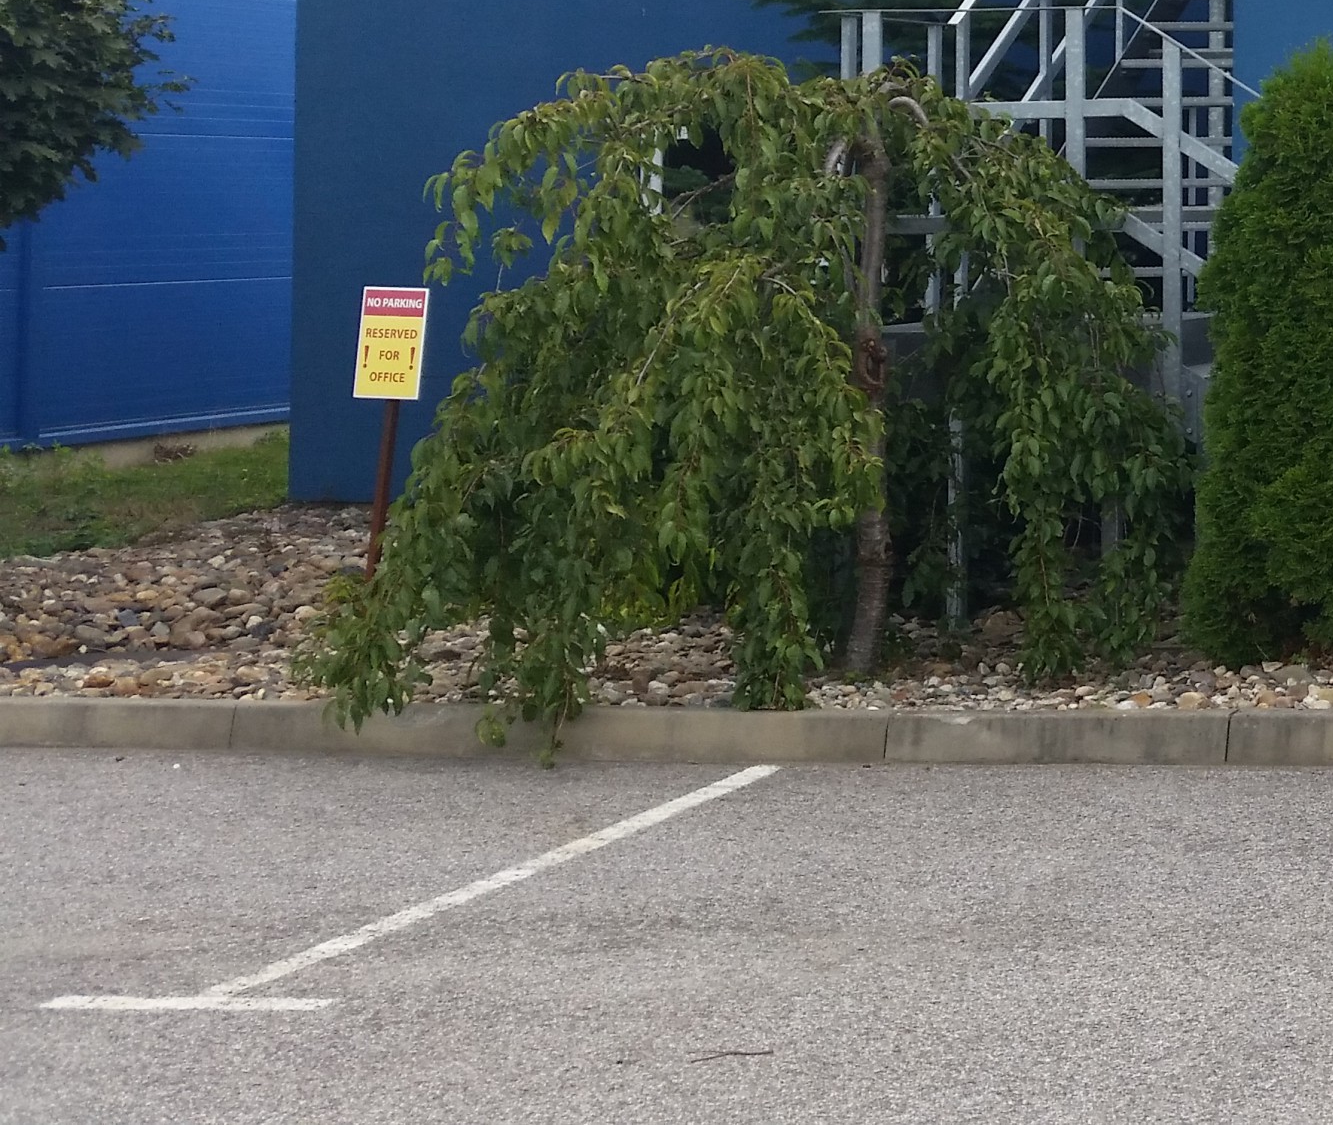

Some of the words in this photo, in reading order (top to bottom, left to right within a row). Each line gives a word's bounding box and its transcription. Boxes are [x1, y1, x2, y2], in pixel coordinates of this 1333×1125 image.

[366, 297, 381, 307] NO
[382, 298, 423, 309] PARKING
[365, 328, 418, 339] RESERVED
[379, 350, 400, 360] FOR
[369, 371, 406, 383] OFFICE
